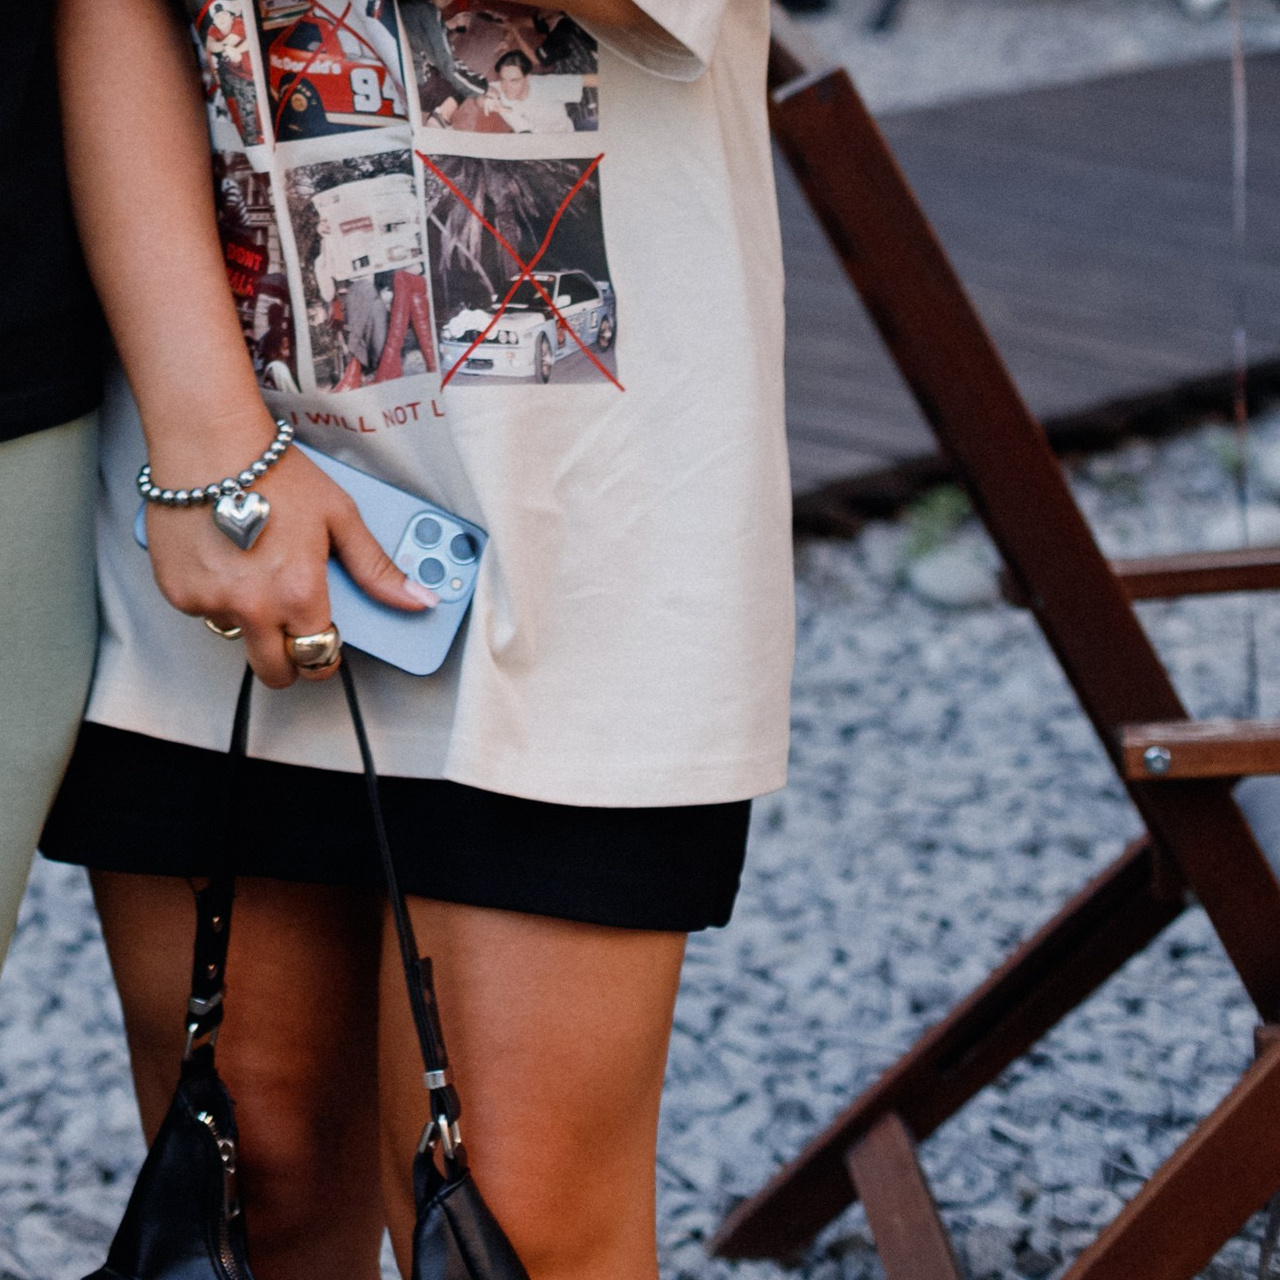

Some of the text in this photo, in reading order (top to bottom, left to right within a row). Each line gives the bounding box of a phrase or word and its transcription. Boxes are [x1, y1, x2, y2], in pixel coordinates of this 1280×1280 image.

[289, 411, 299, 426] I
[305, 411, 377, 433] WILL
[382, 401, 421, 428] NOT
